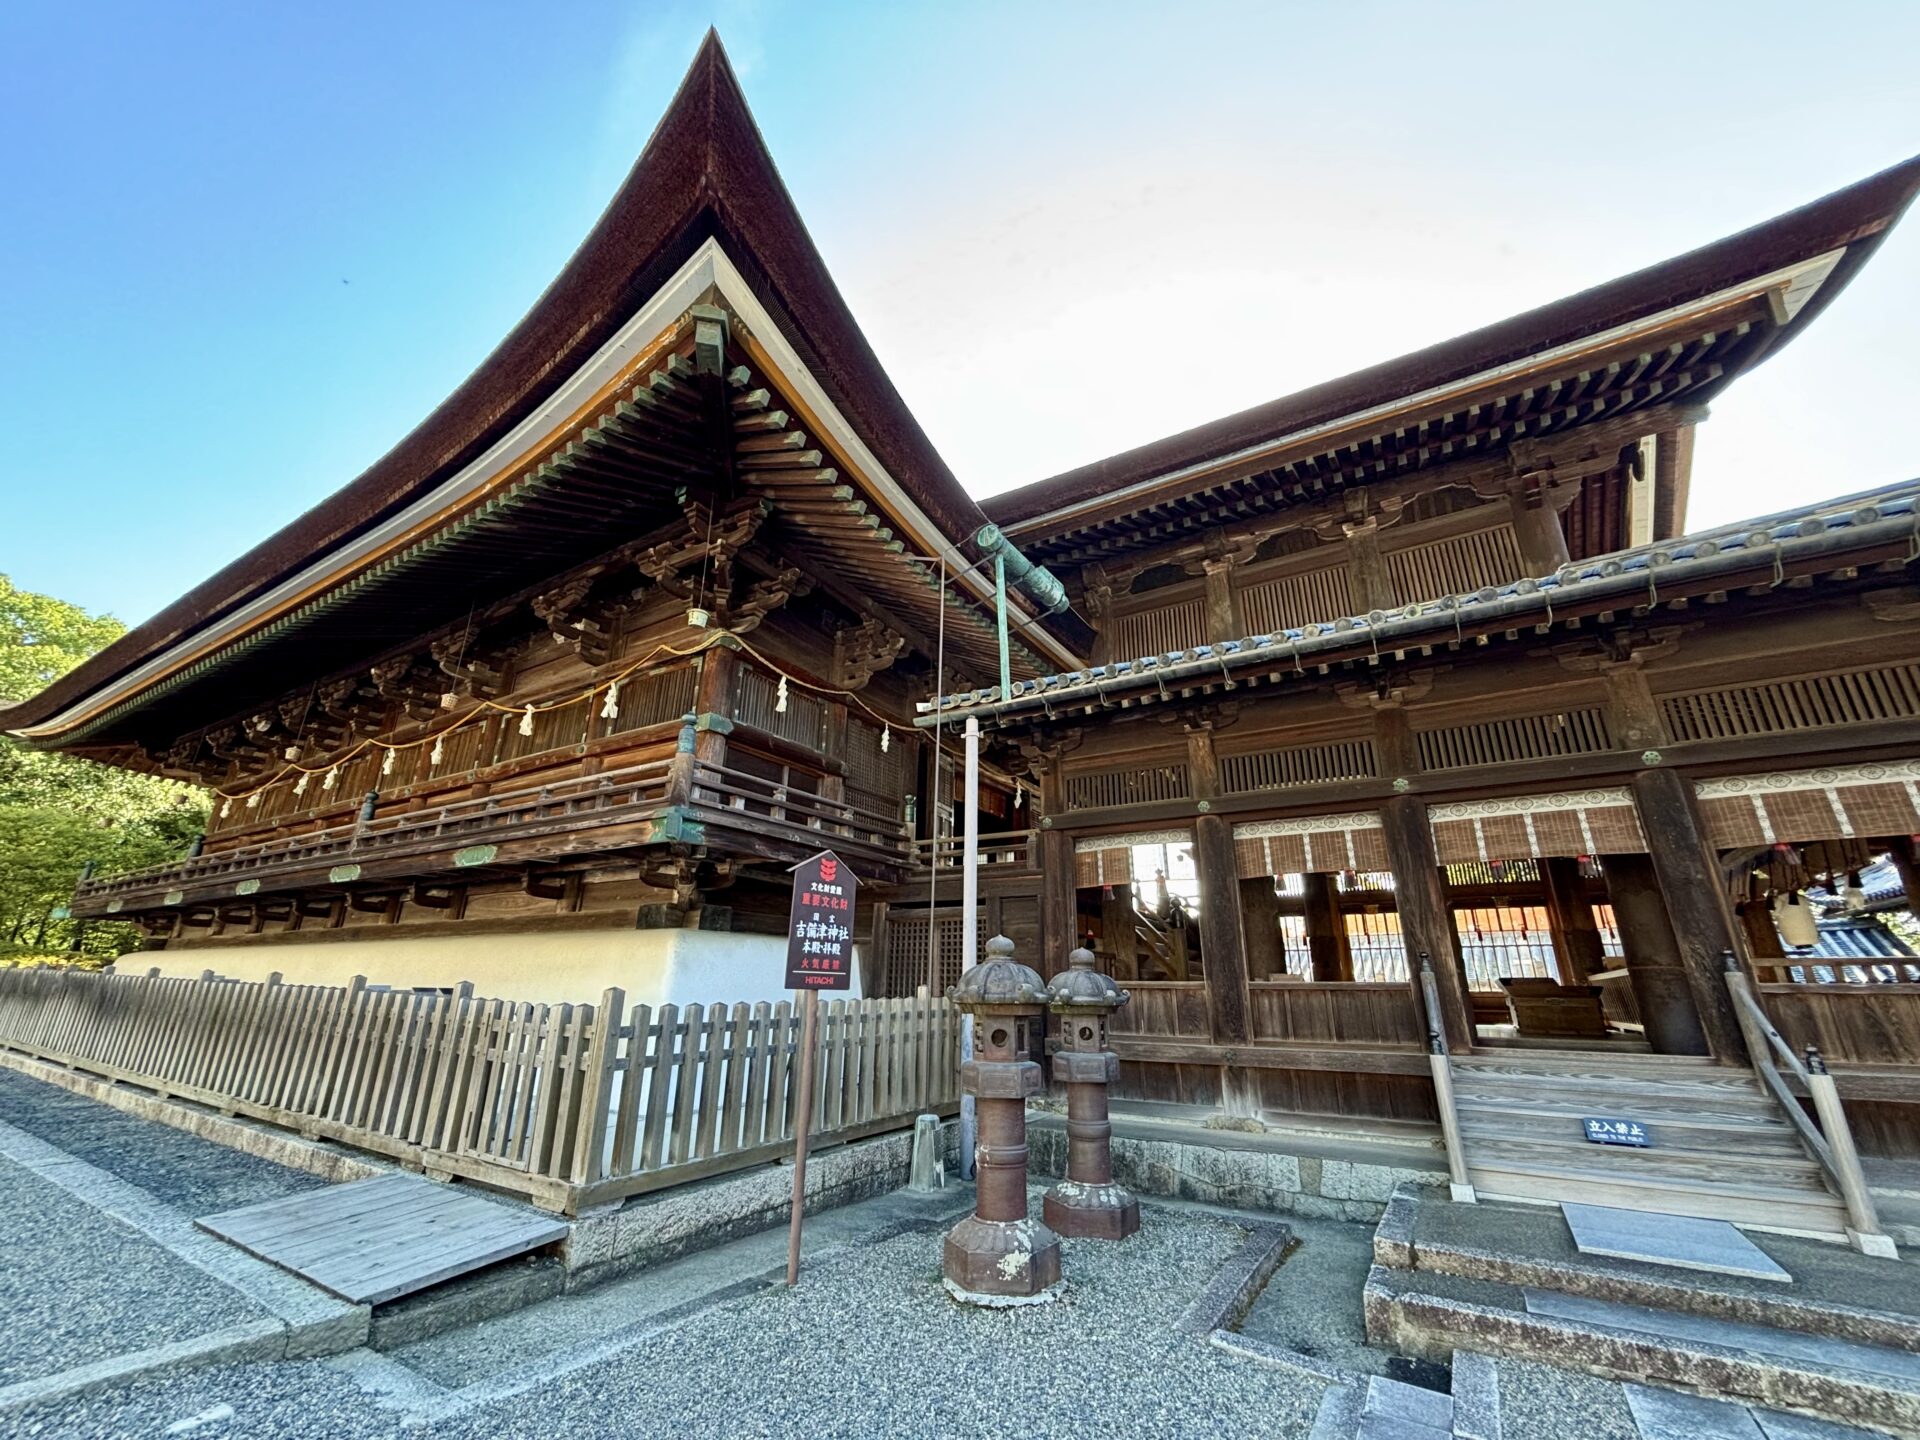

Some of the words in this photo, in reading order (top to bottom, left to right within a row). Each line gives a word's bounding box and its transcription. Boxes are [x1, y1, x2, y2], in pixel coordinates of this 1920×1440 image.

[796, 920, 849, 941] 吉備津神社
[806, 976, 834, 984] HITACHI
[1589, 1120, 1644, 1136] 立入禁止
